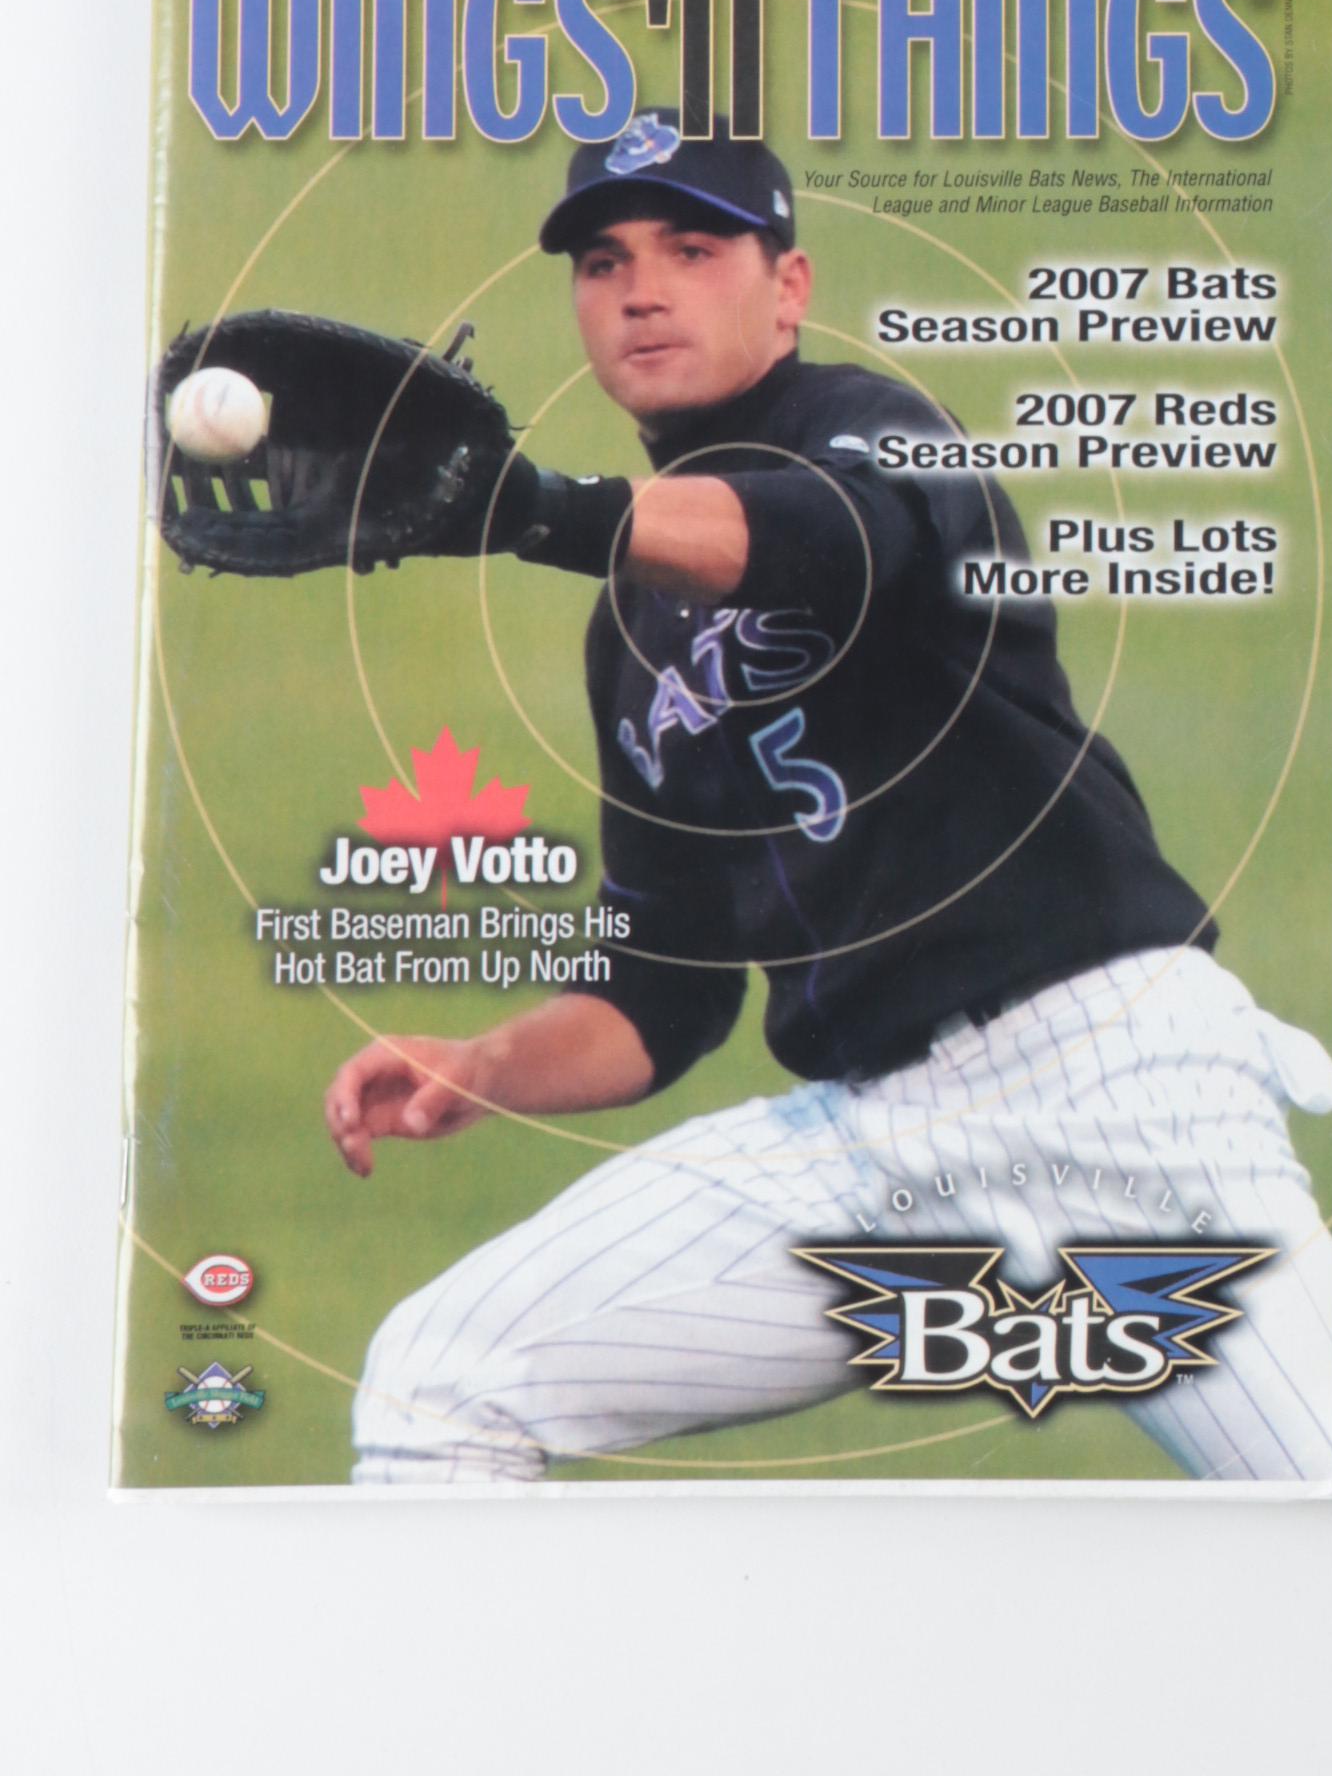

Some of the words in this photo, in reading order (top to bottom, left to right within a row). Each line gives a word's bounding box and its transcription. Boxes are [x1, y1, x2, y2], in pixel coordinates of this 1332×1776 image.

[804, 170, 843, 188] Your
[848, 170, 907, 188] Source
[913, 170, 937, 188] for
[943, 169, 1023, 188] Louisville
[1029, 169, 1065, 187] Bats
[1072, 169, 1122, 189] News,
[1131, 169, 1160, 187] The
[1167, 169, 1273, 187] International
[872, 196, 932, 216] League
[939, 196, 971, 214] and
[976, 195, 1026, 214] Minor
[1032, 196, 1092, 216] League
[1099, 195, 1169, 213] Baseball
[1175, 195, 1273, 213] Information
[1028, 267, 1149, 300] 2007
[1167, 267, 1277, 300] Bats
[878, 309, 1059, 342] Season
[1078, 309, 1277, 342] Preview
[1016, 393, 1137, 426] 2007
[1155, 393, 1277, 426] Reds
[877, 435, 1059, 469] Season
[1078, 435, 1277, 469] Preview
[1049, 519, 1155, 553] Plus
[1173, 519, 1277, 553] Lots
[964, 562, 1089, 595] More
[1108, 562, 1275, 595] Inside!
[748, 708, 848, 842] 5
[319, 837, 438, 894] Joey
[451, 836, 577, 883] Votto
[256, 908, 321, 941] First
[331, 907, 469, 940] Baseman
[480, 906, 575, 945] Brings
[584, 906, 631, 939] His
[274, 952, 326, 985] Hot
[335, 952, 386, 984] Bat
[395, 951, 470, 983] From
[481, 950, 520, 989] Up
[530, 950, 611, 982] North
[856, 1162, 1212, 1234] LOUISVILLE
[204, 1273, 250, 1287] REDS
[901, 1288, 1166, 1383] Bats
